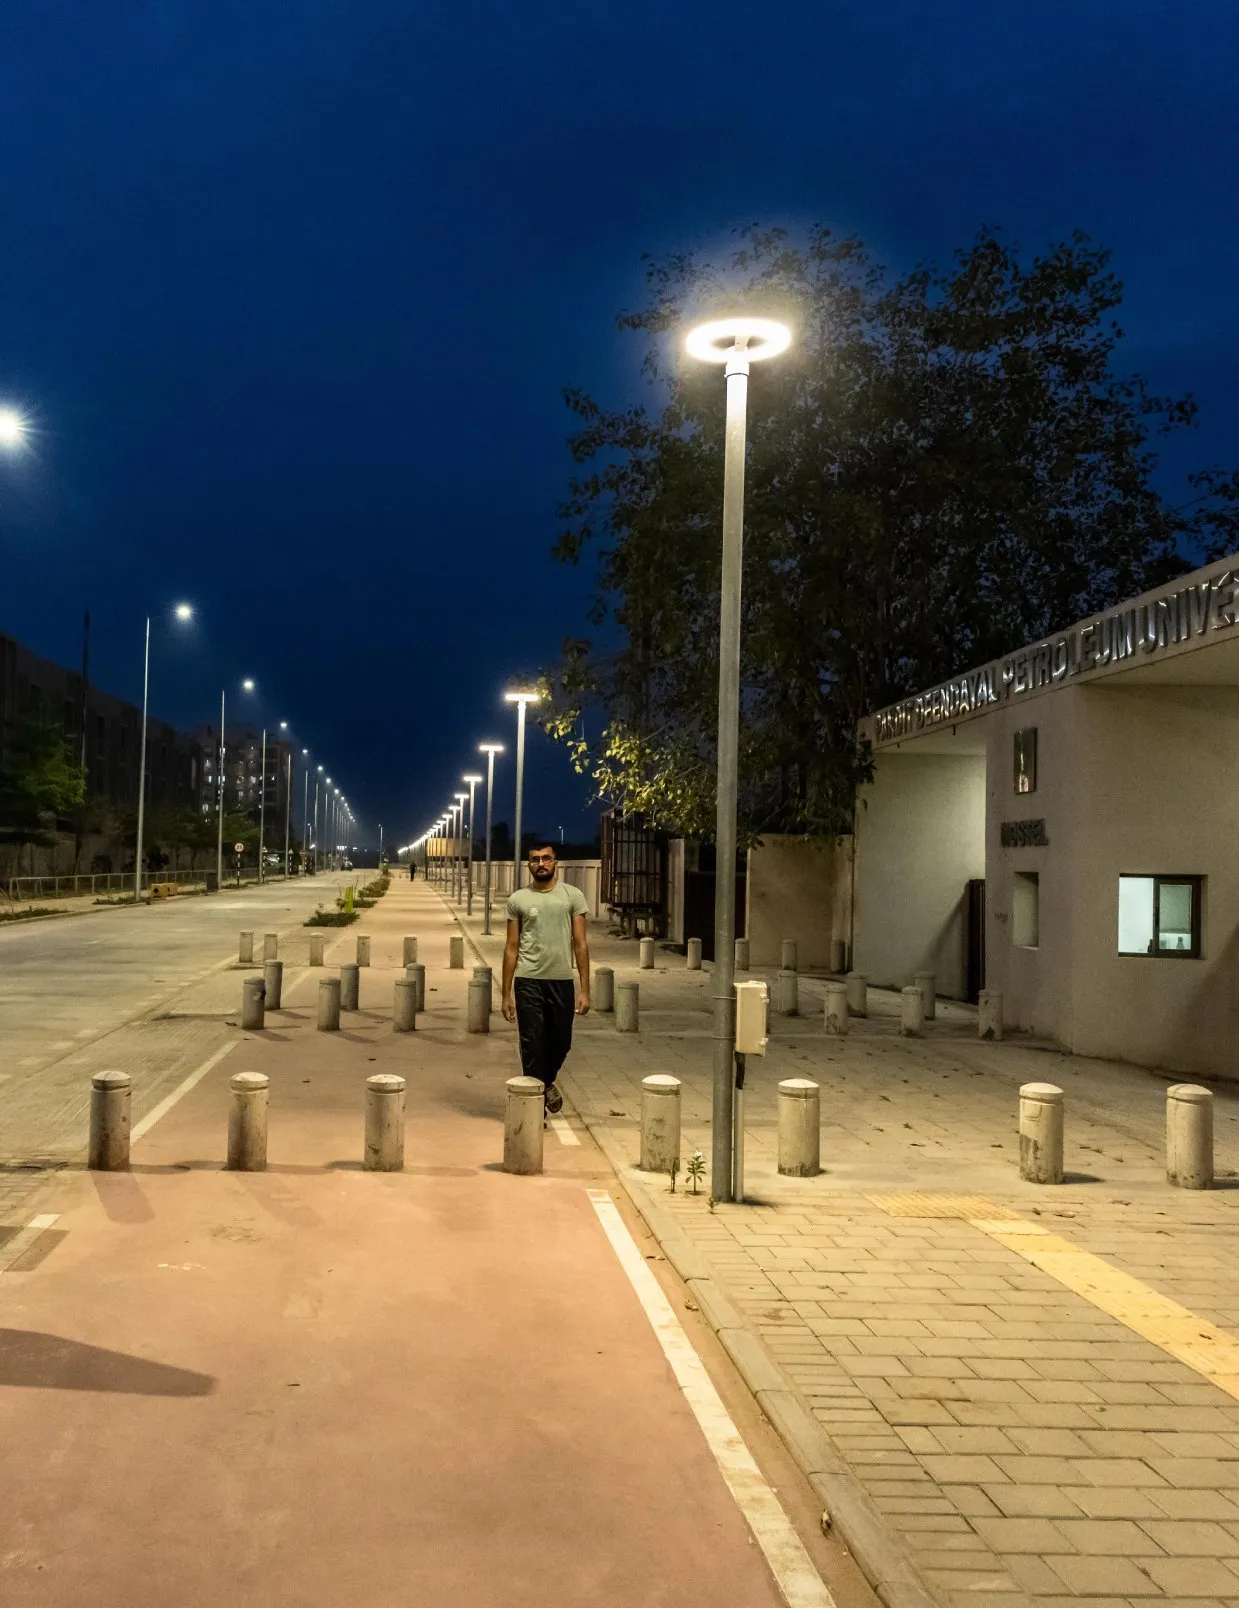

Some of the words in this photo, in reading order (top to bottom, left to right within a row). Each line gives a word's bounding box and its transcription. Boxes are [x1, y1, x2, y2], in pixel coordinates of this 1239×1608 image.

[876, 702, 914, 743] PANDIT
[916, 667, 999, 729] DEENDAYAL
[1003, 607, 1136, 700] PETROLEUM
[1138, 570, 1239, 655] UNIVE
